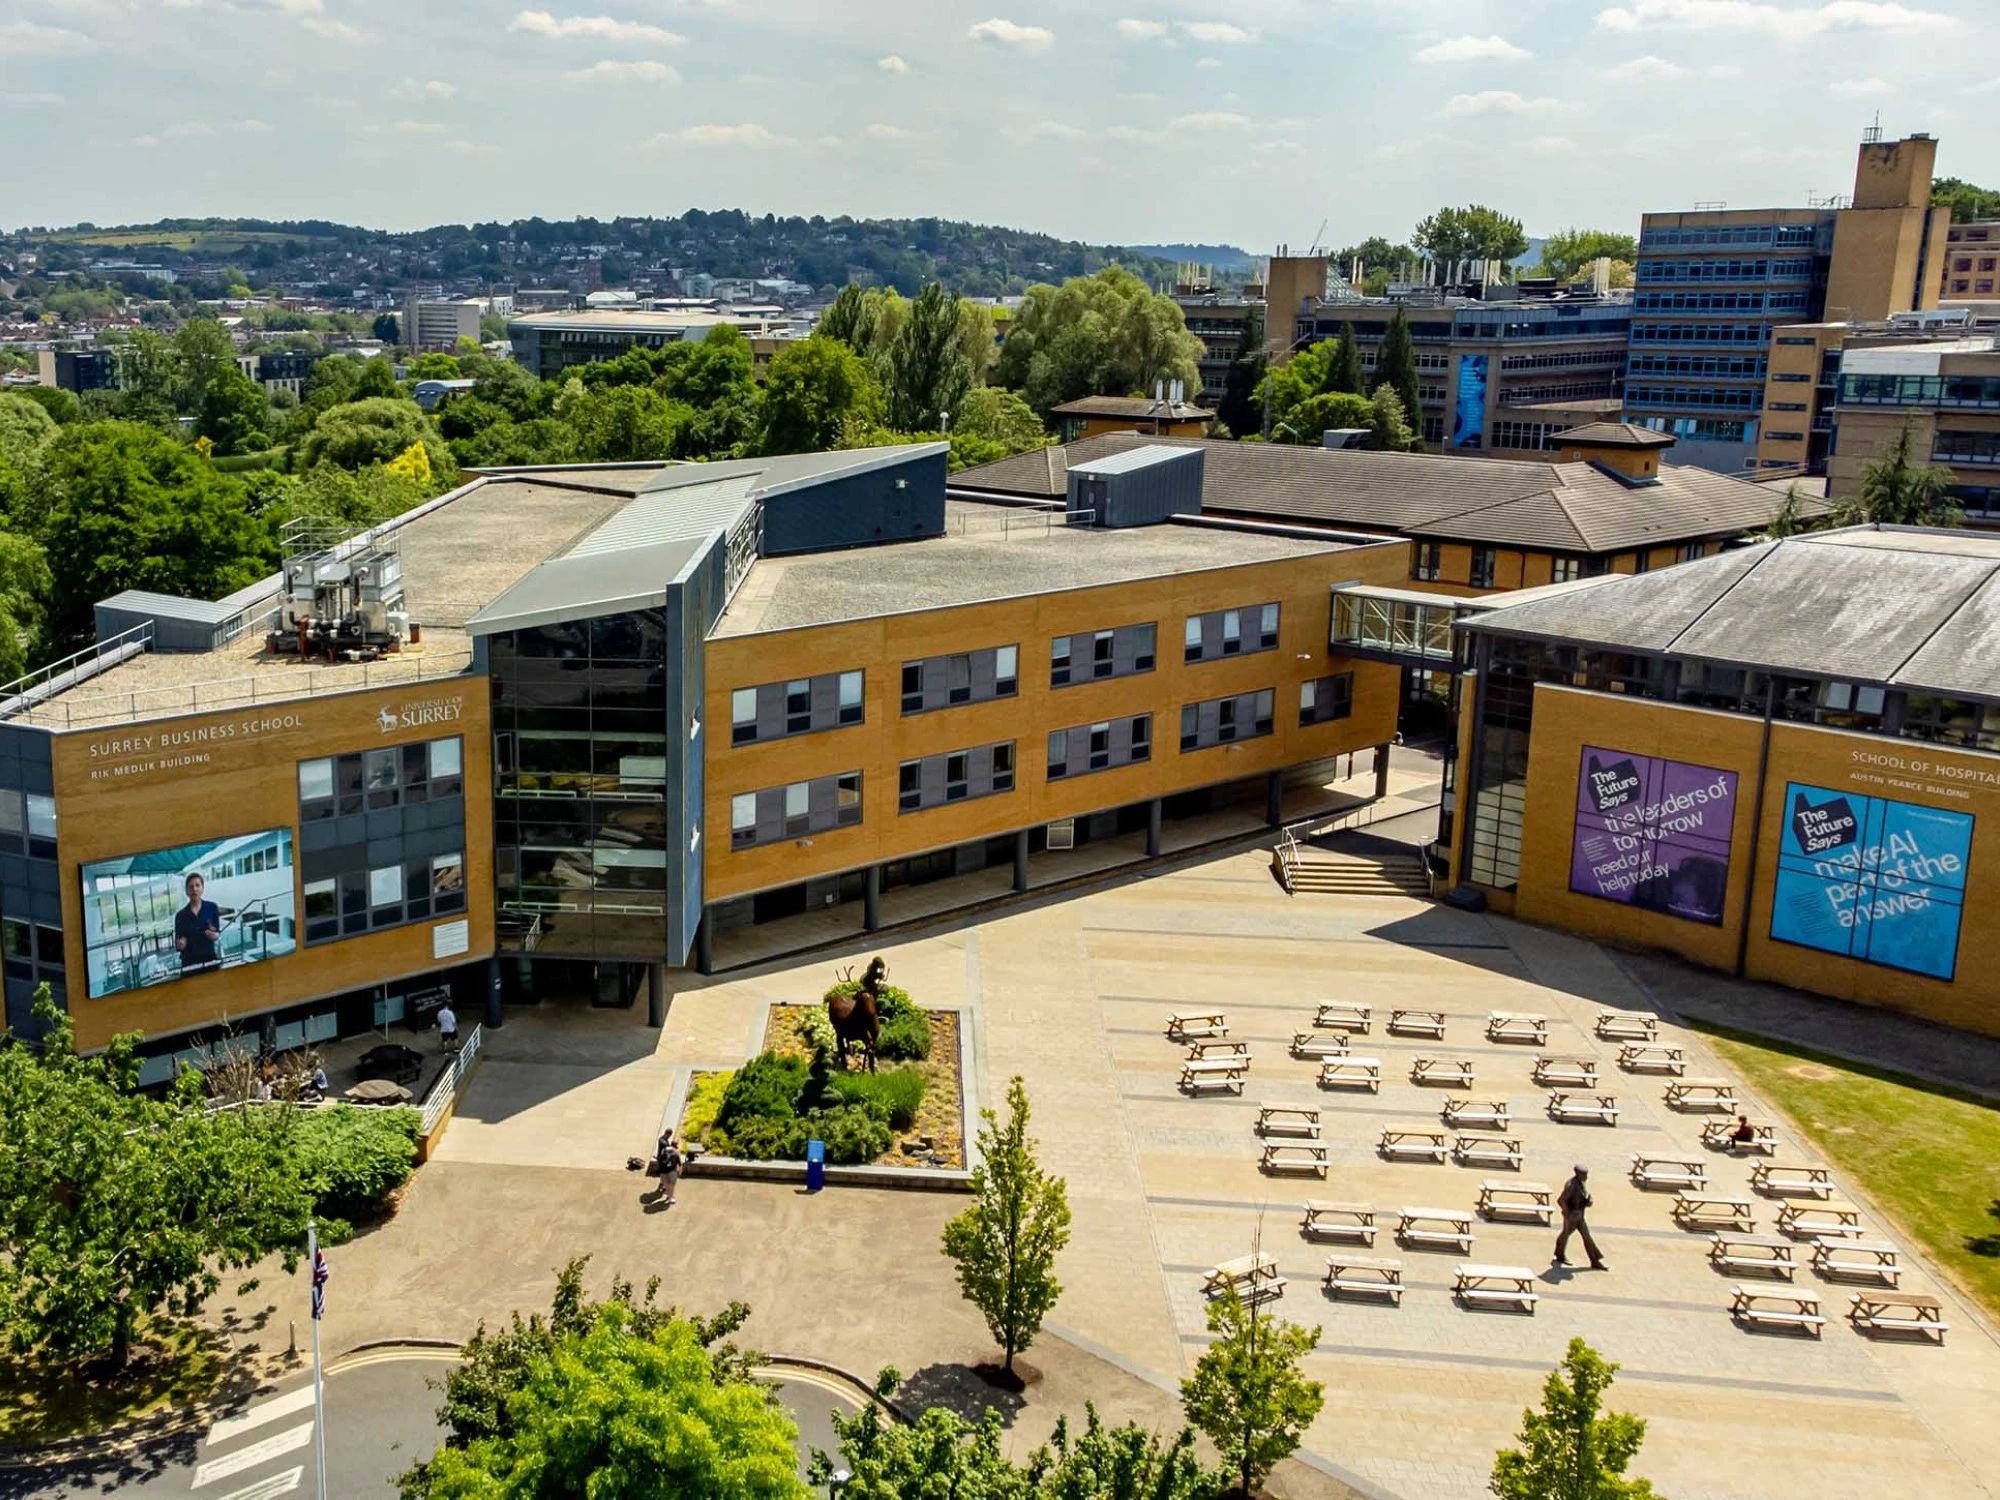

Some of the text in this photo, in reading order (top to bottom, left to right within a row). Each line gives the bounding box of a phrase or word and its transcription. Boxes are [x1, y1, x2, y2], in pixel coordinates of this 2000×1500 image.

[401, 703, 463, 728] SURREY
[90, 715, 303, 757] SURREY BUSINESS SCHOOL
[91, 753, 211, 779] RIK MEDLIK BUILDING
[1852, 750, 1907, 769] SCHOOL
[1911, 761, 1930, 772] OF
[1591, 769, 1618, 785] The
[1596, 776, 1639, 797] Future
[1850, 772, 1969, 799] AUSTIN PEARCE BUILDING
[1599, 792, 1628, 810] Says
[1604, 776, 1729, 833] the leaders of
[1797, 809, 1828, 825] The
[1803, 816, 1854, 838] Future
[1612, 811, 1704, 851] tomorrow
[1806, 833, 1842, 852] Says
[1592, 850, 1651, 877] need our
[1814, 829, 1919, 880] make AI
[1597, 862, 1669, 894] help today
[1825, 852, 1961, 910] part of the
[1837, 887, 1932, 928] answer
